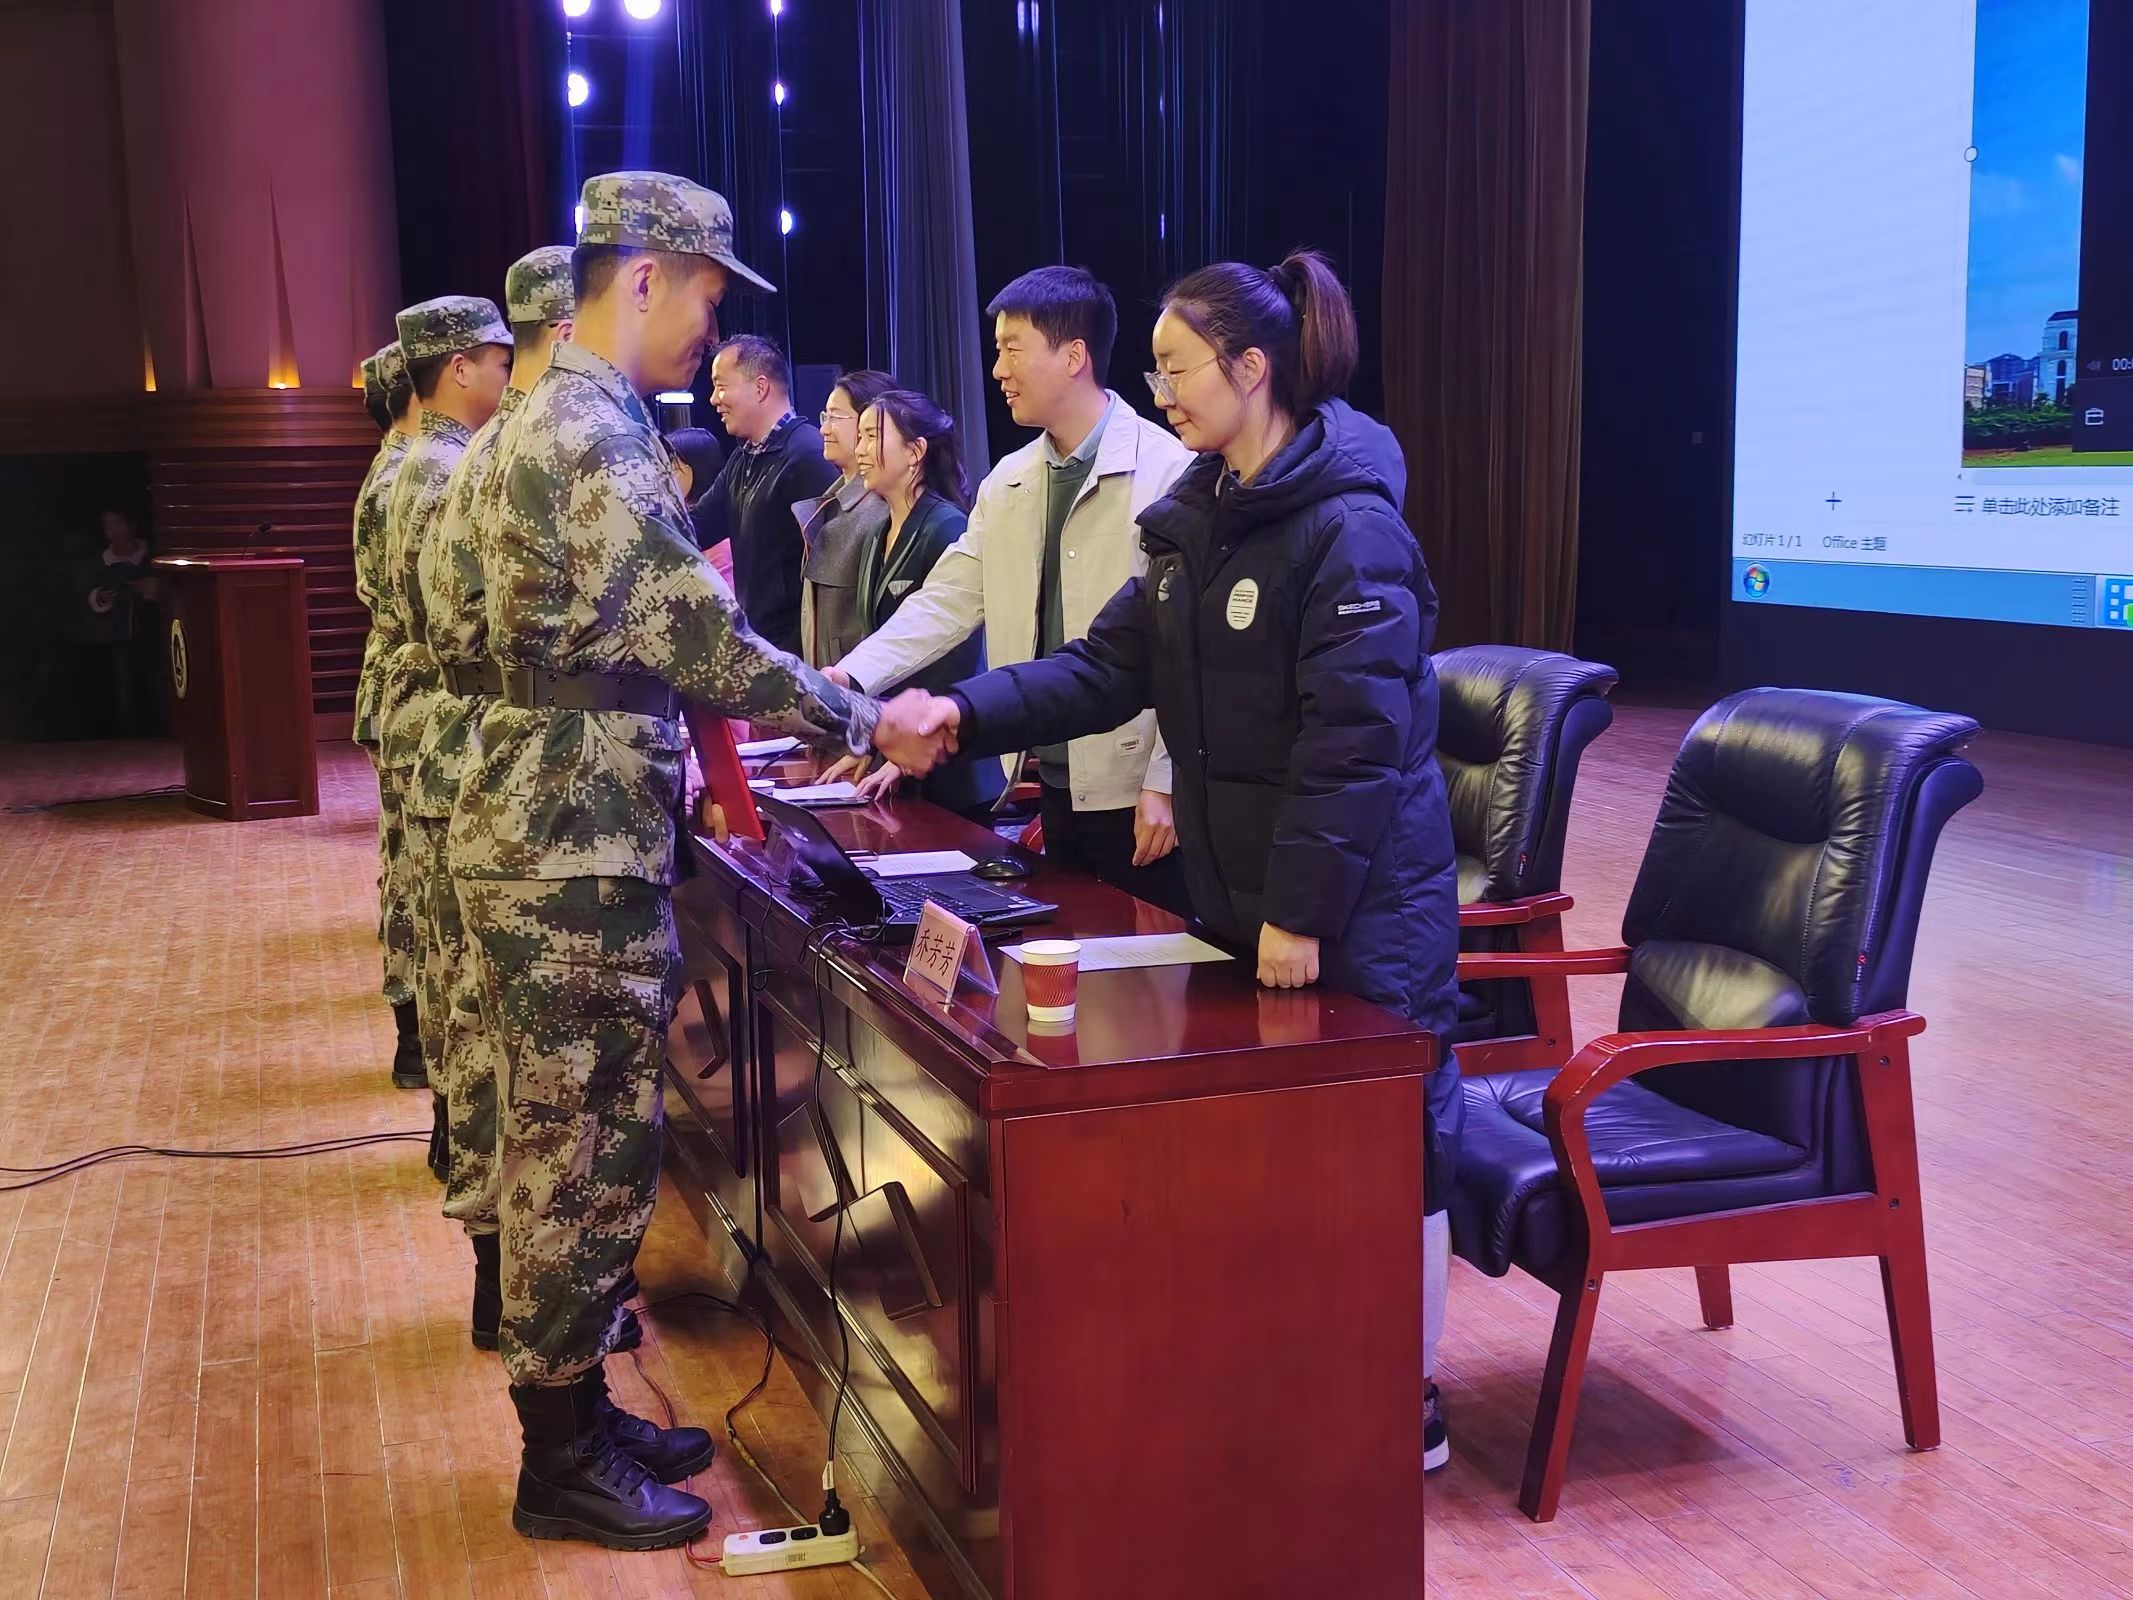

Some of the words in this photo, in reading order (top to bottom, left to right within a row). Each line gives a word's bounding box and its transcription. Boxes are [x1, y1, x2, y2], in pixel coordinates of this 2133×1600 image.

[2112, 358, 2133, 371] 00:
[1981, 496, 2121, 517] 单击此处添加备注
[1822, 535, 1858, 549] Office
[1860, 536, 1887, 551] 主题
[915, 928, 956, 977] 乔芳芳
